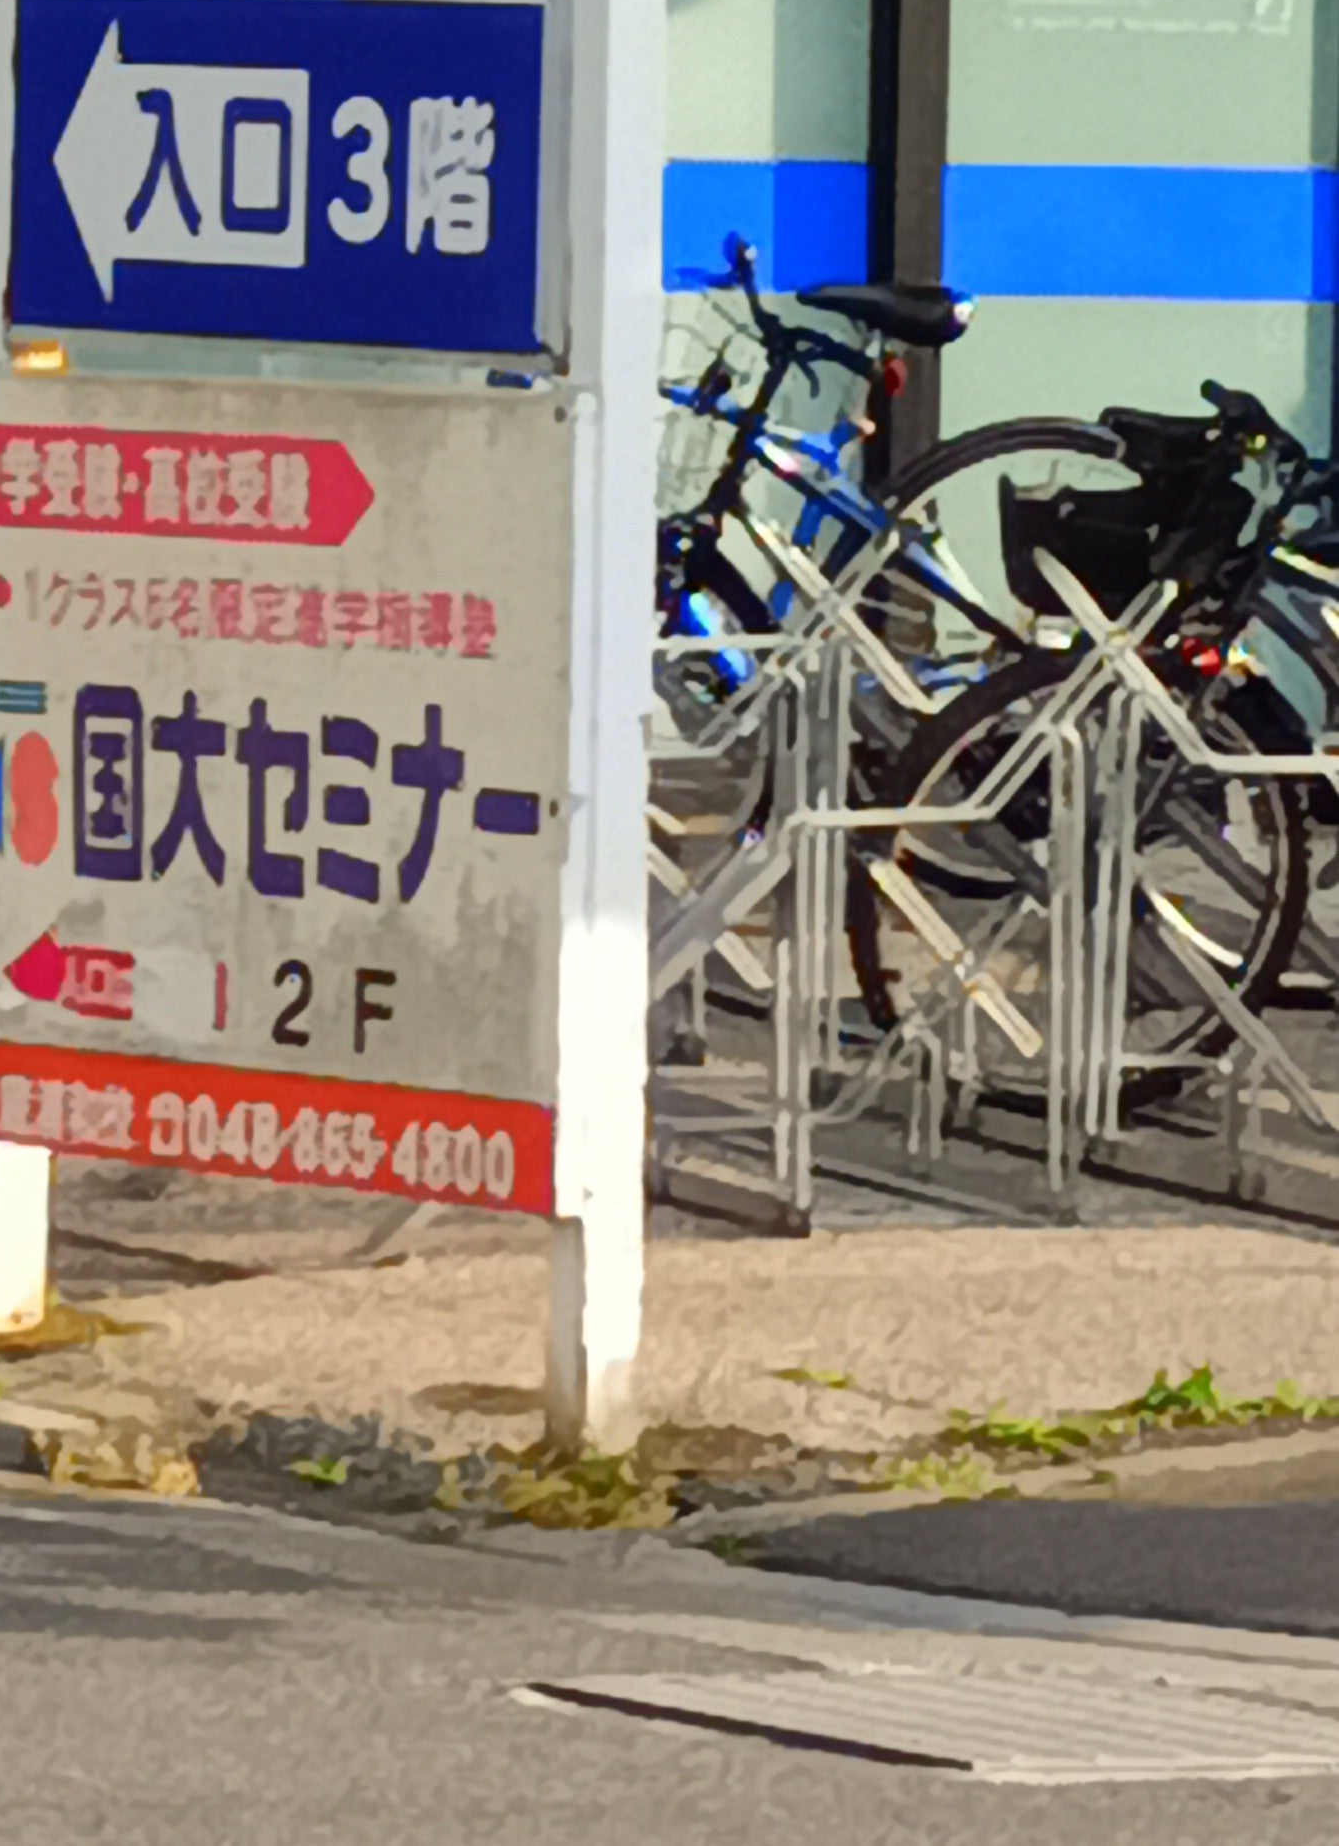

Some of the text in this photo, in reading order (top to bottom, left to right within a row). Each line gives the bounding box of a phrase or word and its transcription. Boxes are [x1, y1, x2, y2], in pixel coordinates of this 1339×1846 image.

[124, 88, 496, 255] 入口 3階
[73, 683, 541, 904] 国大セミナー
